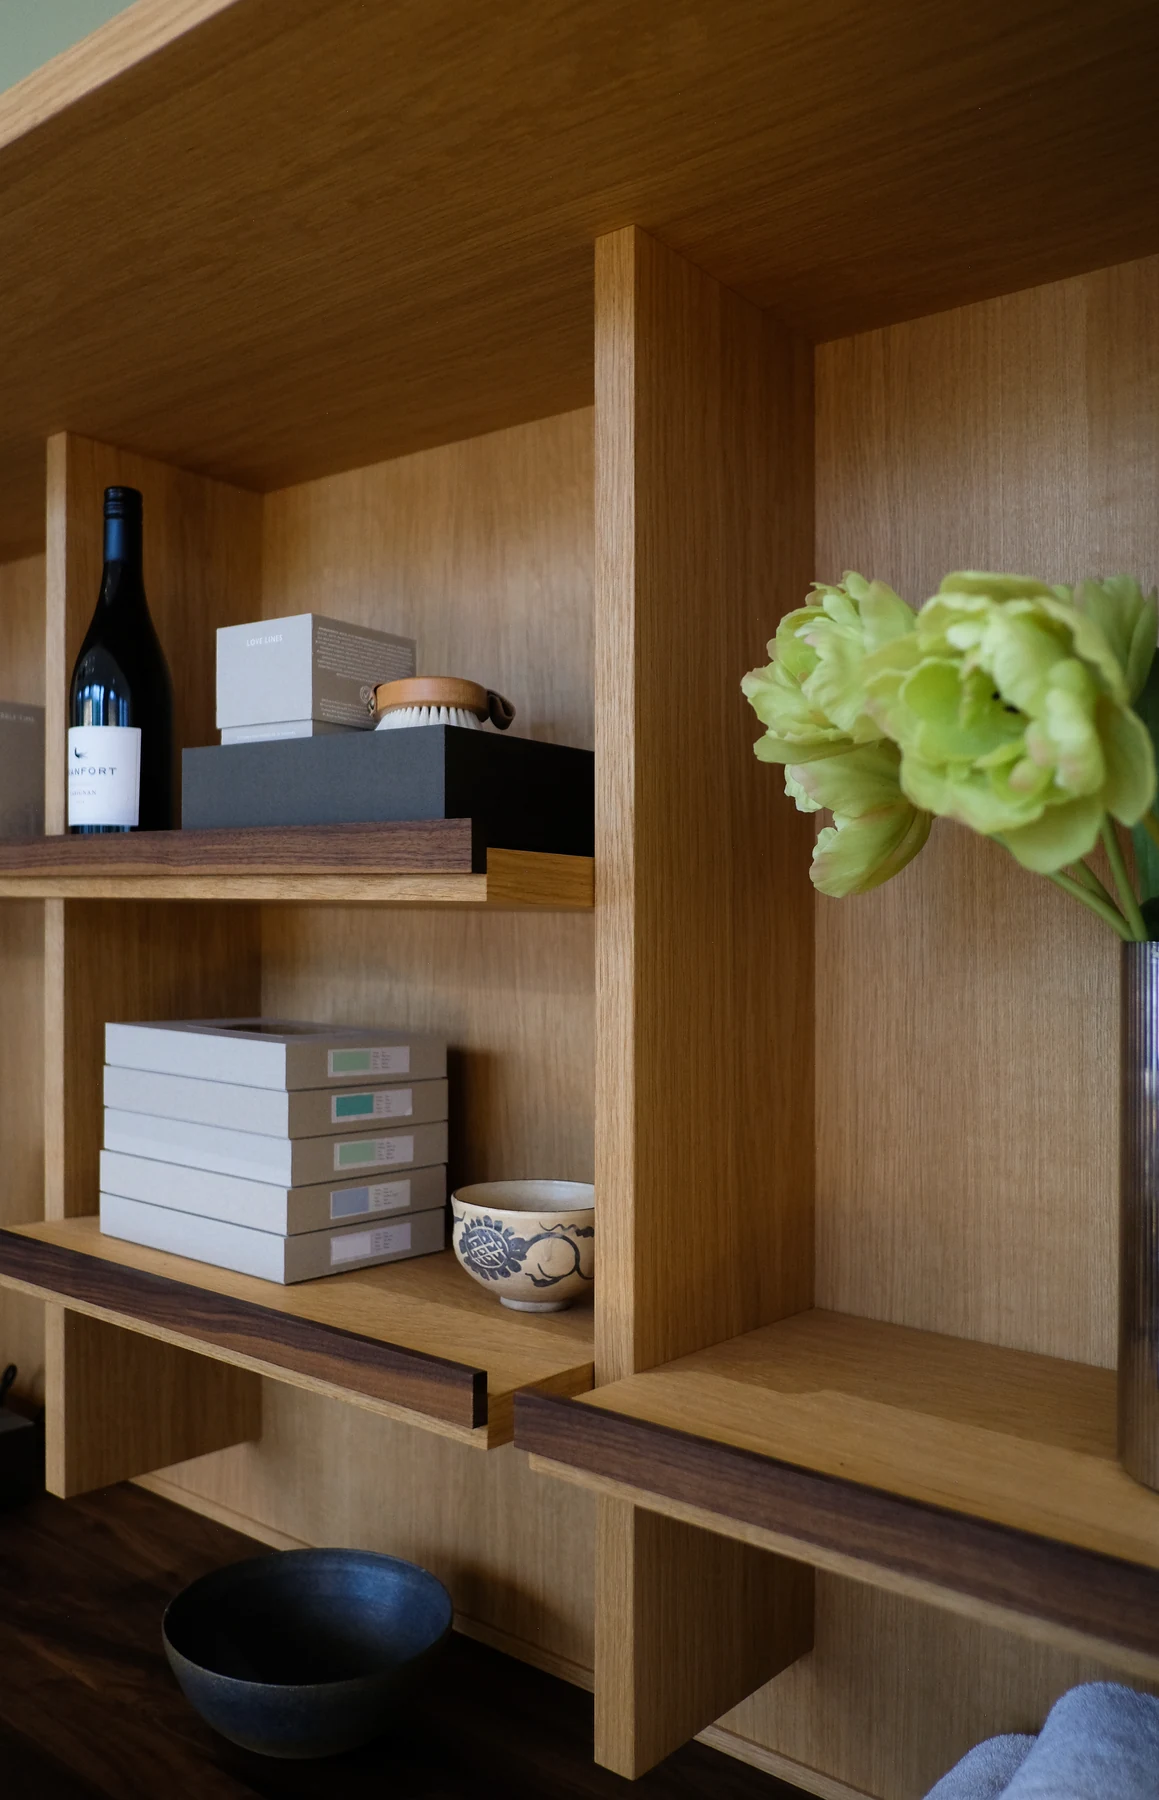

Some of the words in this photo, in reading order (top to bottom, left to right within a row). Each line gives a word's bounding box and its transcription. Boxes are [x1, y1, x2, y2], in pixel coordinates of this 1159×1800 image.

[246, 637, 263, 647] LOVE
[264, 634, 283, 644] LINES
[68, 766, 117, 776] ANFORT
